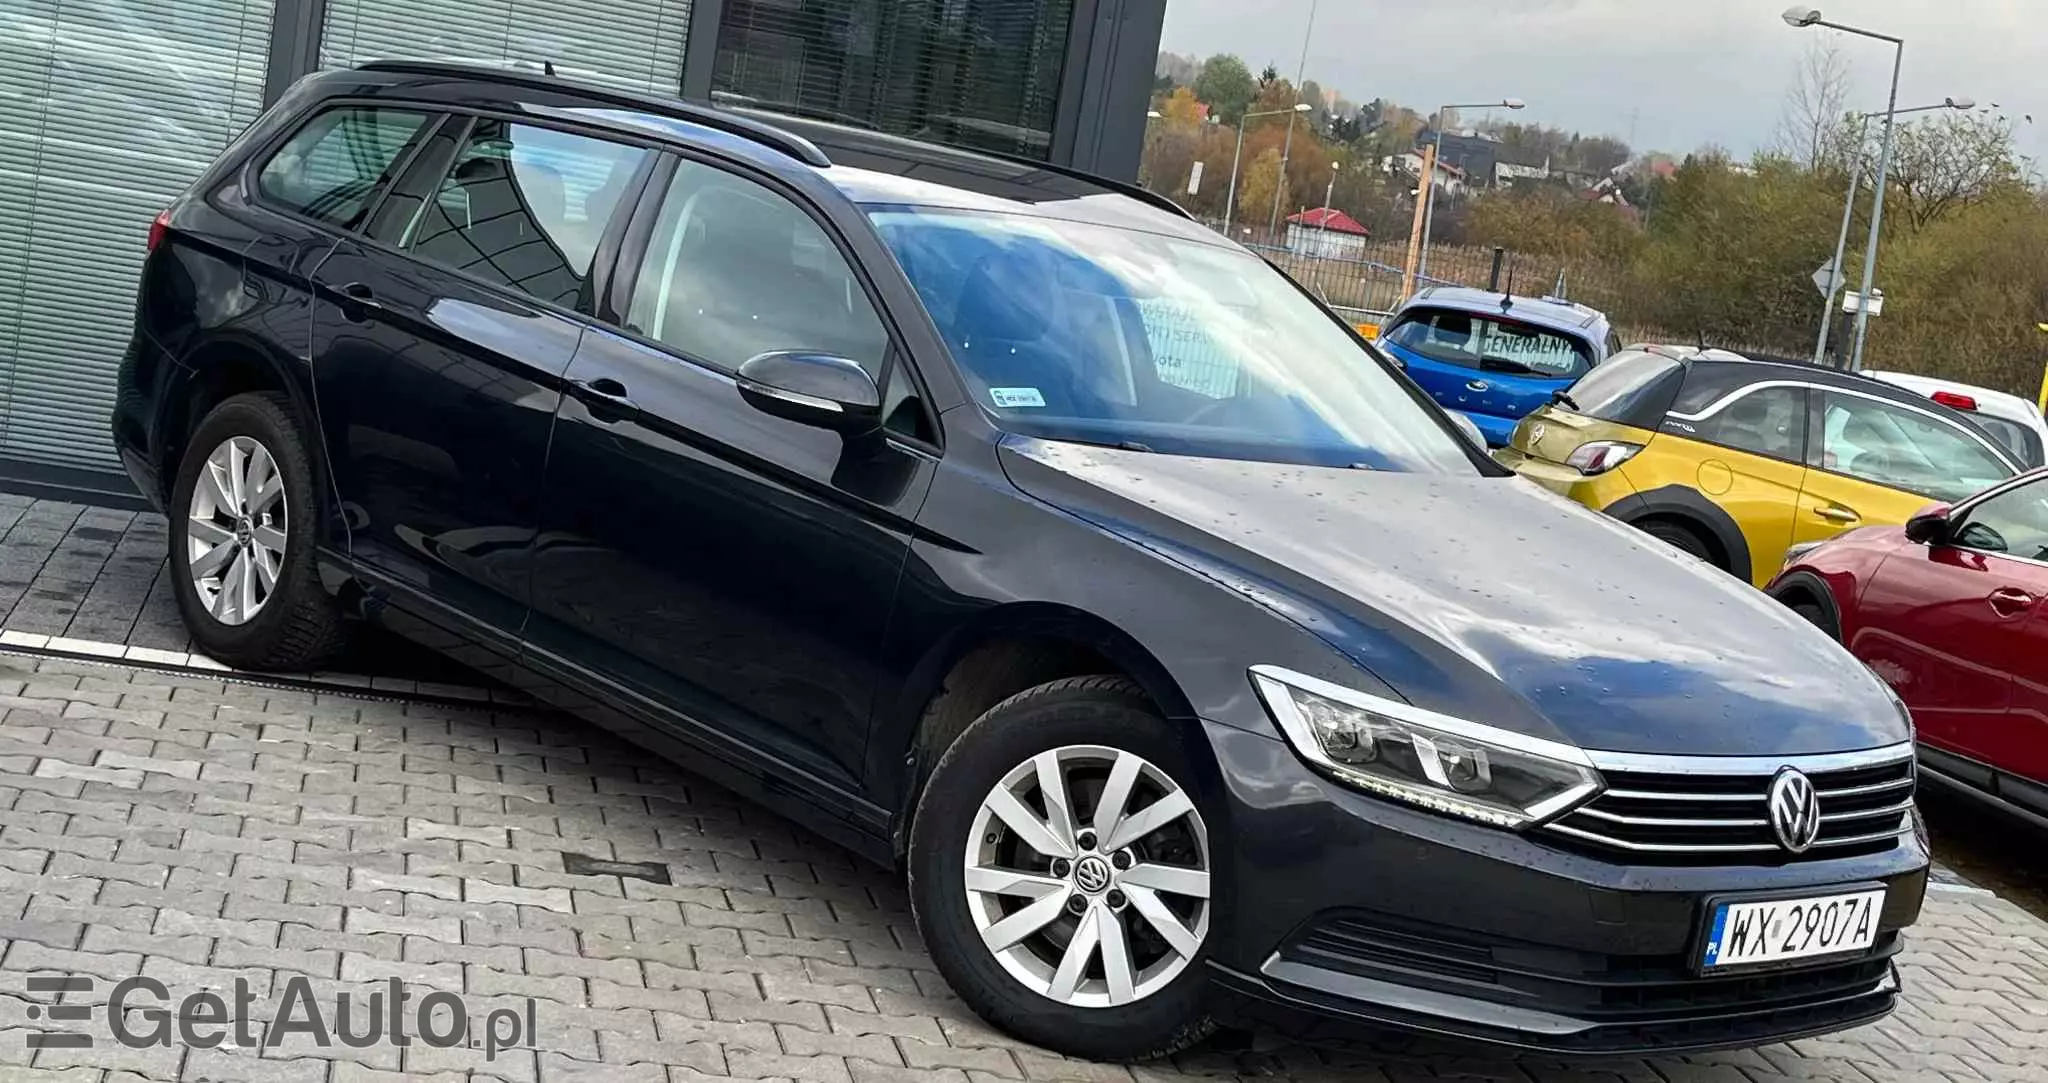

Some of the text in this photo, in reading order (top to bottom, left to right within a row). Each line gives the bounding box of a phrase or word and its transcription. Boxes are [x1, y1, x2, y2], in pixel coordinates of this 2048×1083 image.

[1728, 896, 1872, 957] WX 2907A
[1706, 942, 1717, 956] PL
